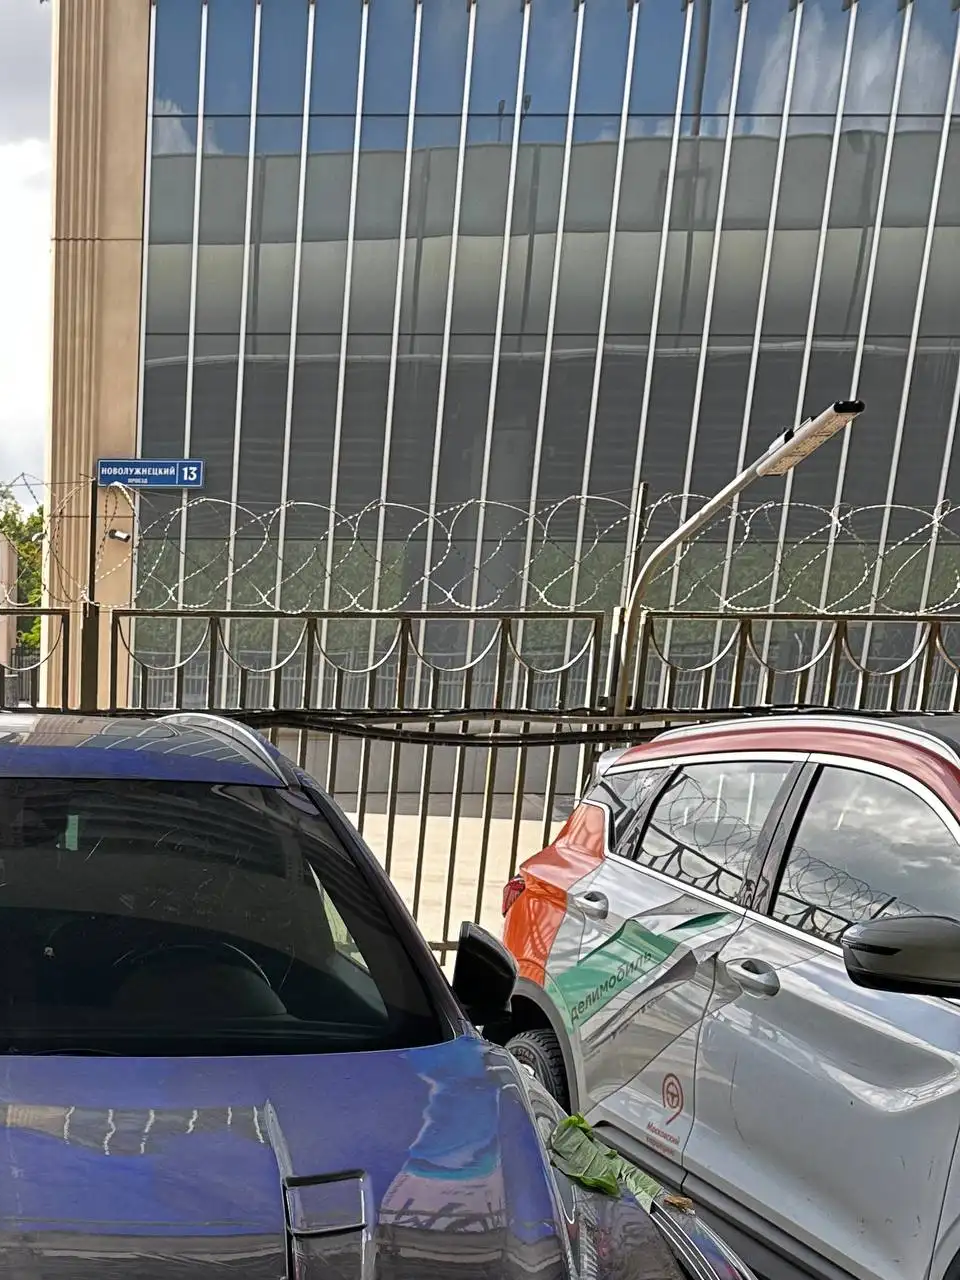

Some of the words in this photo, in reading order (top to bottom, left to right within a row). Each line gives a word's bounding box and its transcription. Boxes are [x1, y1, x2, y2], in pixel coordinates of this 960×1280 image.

[101, 466, 175, 476] НОВОЛУЖНЕЦКИЙ
[182, 466, 198, 481] 13
[571, 952, 652, 1024] делимобиль
